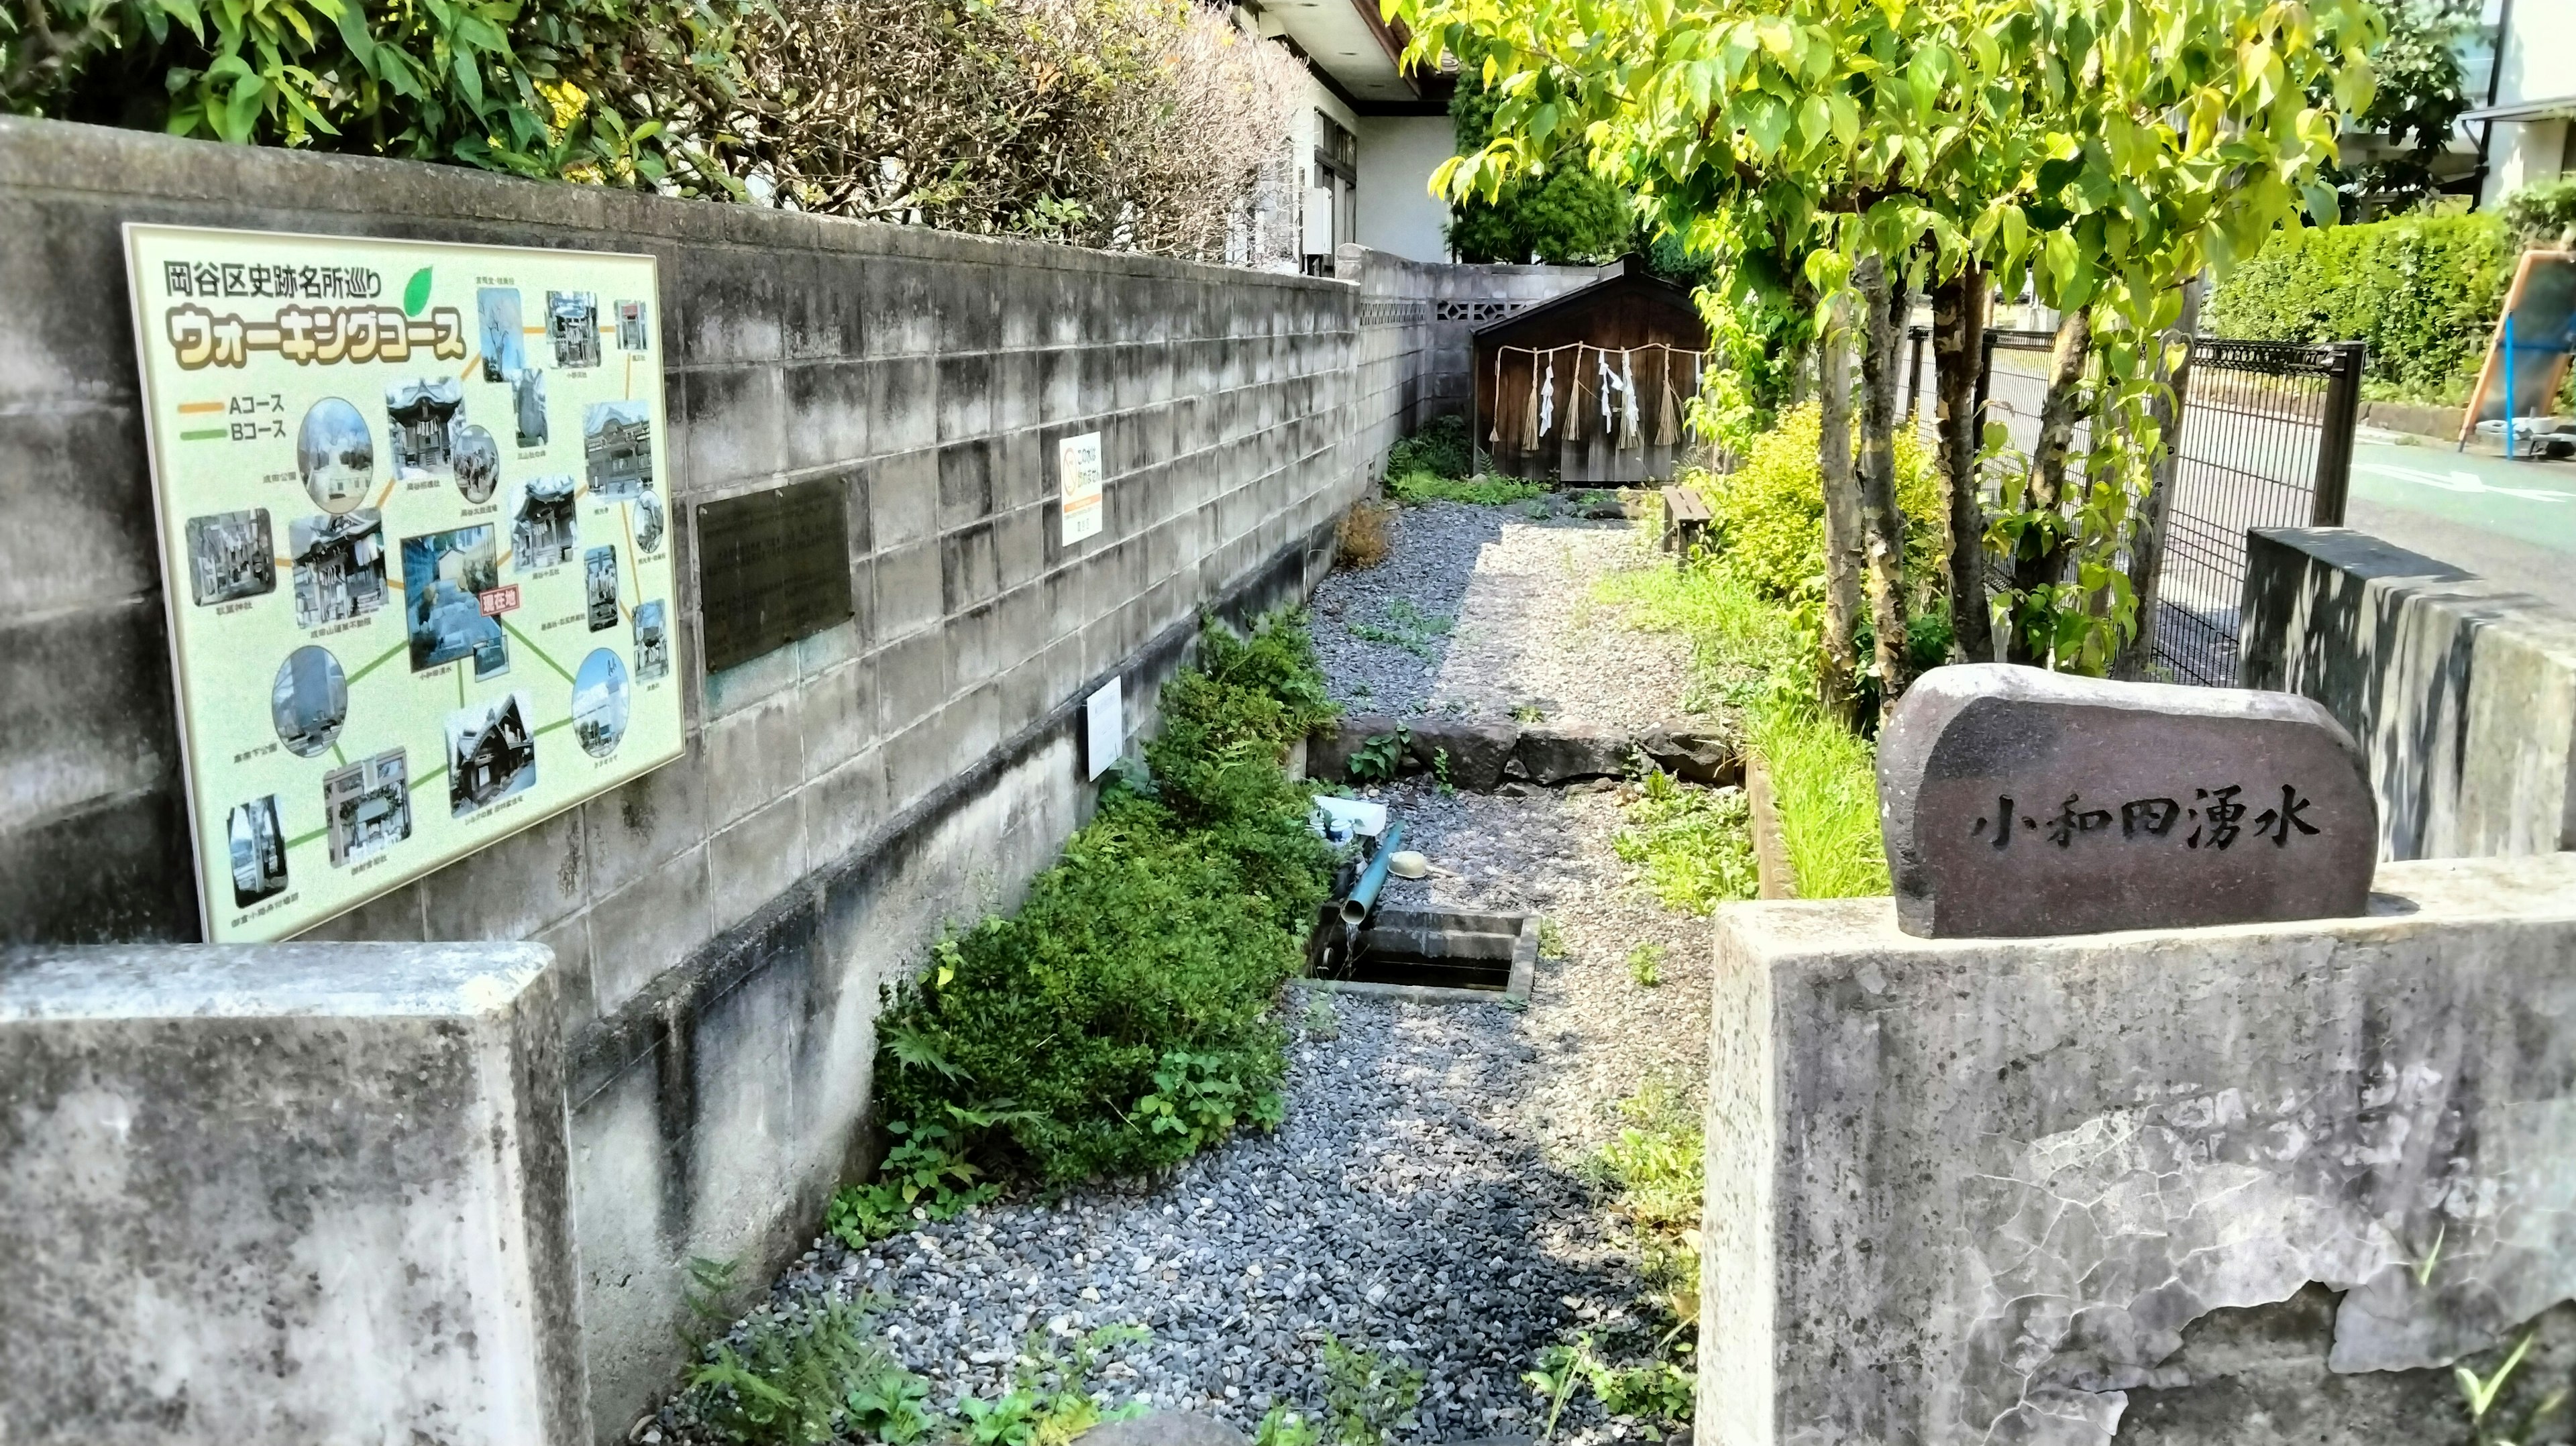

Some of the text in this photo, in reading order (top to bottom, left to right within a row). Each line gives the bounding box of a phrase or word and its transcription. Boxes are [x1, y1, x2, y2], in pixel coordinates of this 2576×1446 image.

[163, 260, 382, 299] 岡谷区史跡名所巡り
[166, 302, 467, 370] ウォーキングコース
[229, 394, 285, 414] Aコース
[231, 419, 286, 441] Bコース
[482, 590, 516, 612] 現在地
[1970, 784, 2320, 851] 小和田湧水
